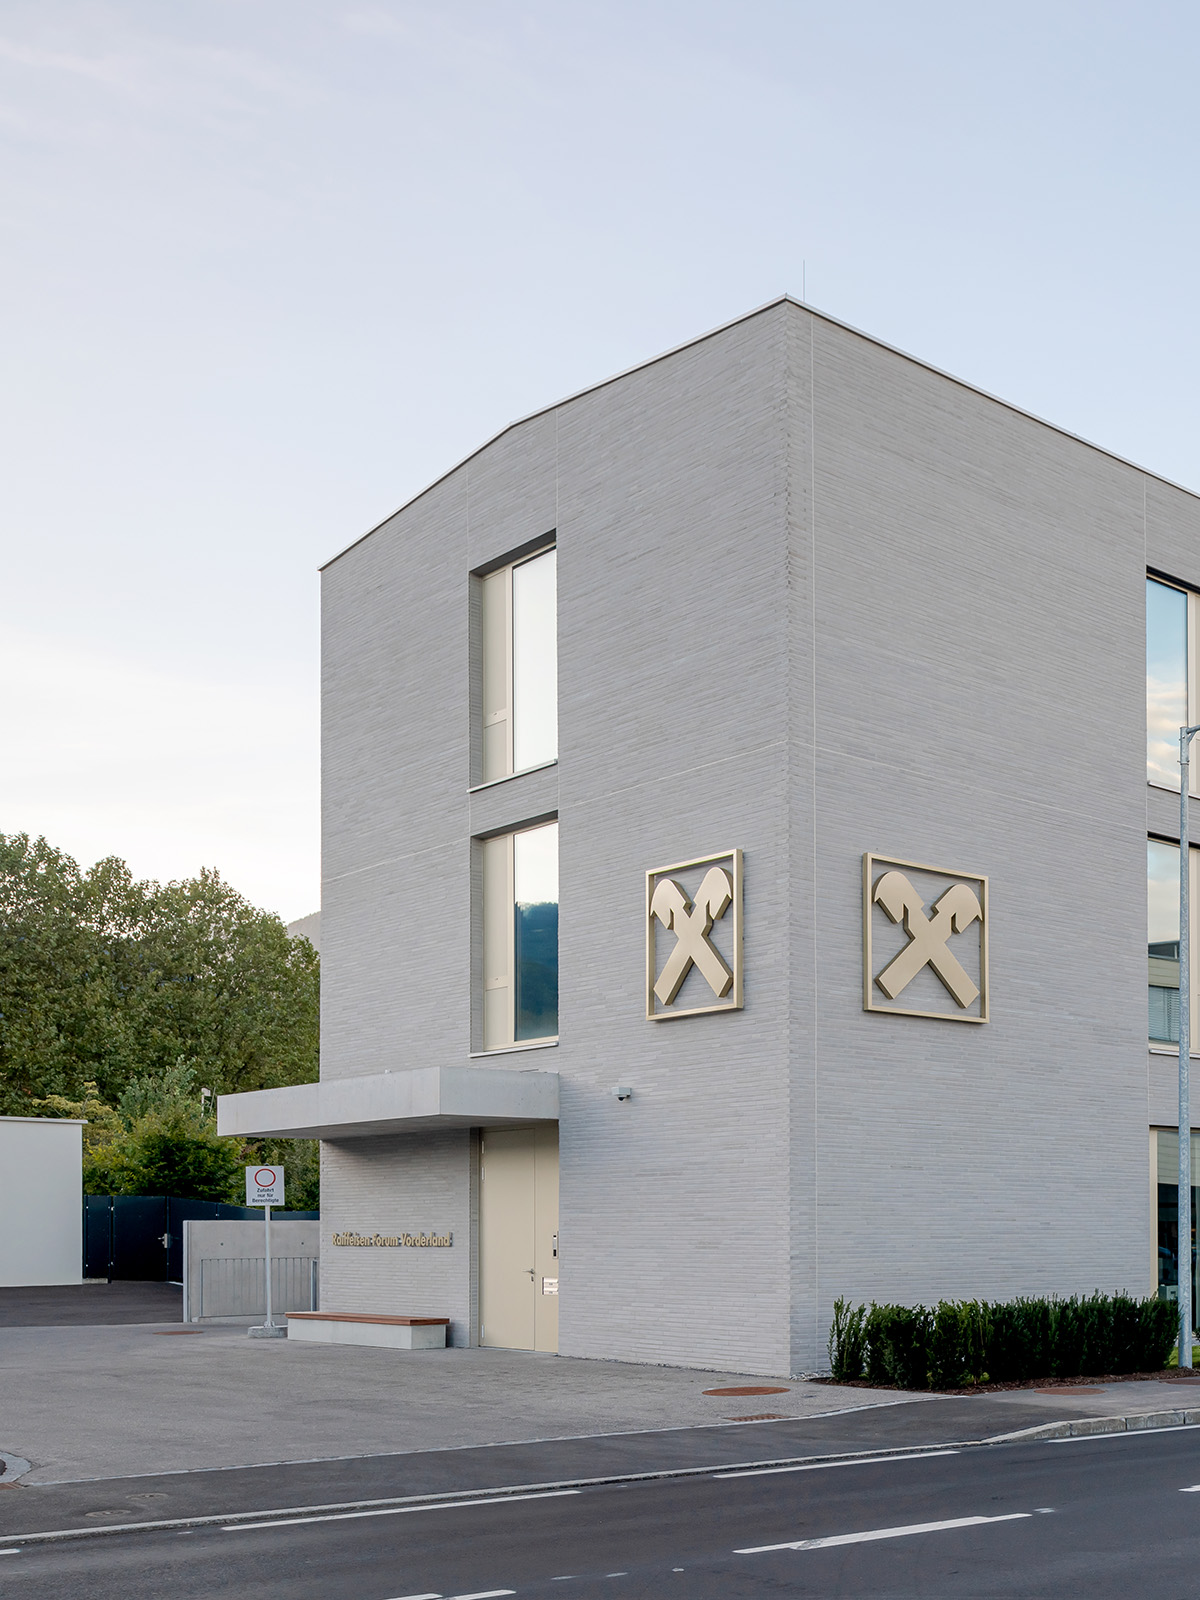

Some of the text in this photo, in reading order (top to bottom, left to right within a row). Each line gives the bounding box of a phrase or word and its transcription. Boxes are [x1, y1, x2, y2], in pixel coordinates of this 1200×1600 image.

[332, 1232, 452, 1247] Raiffeisen Forum Vorderland
